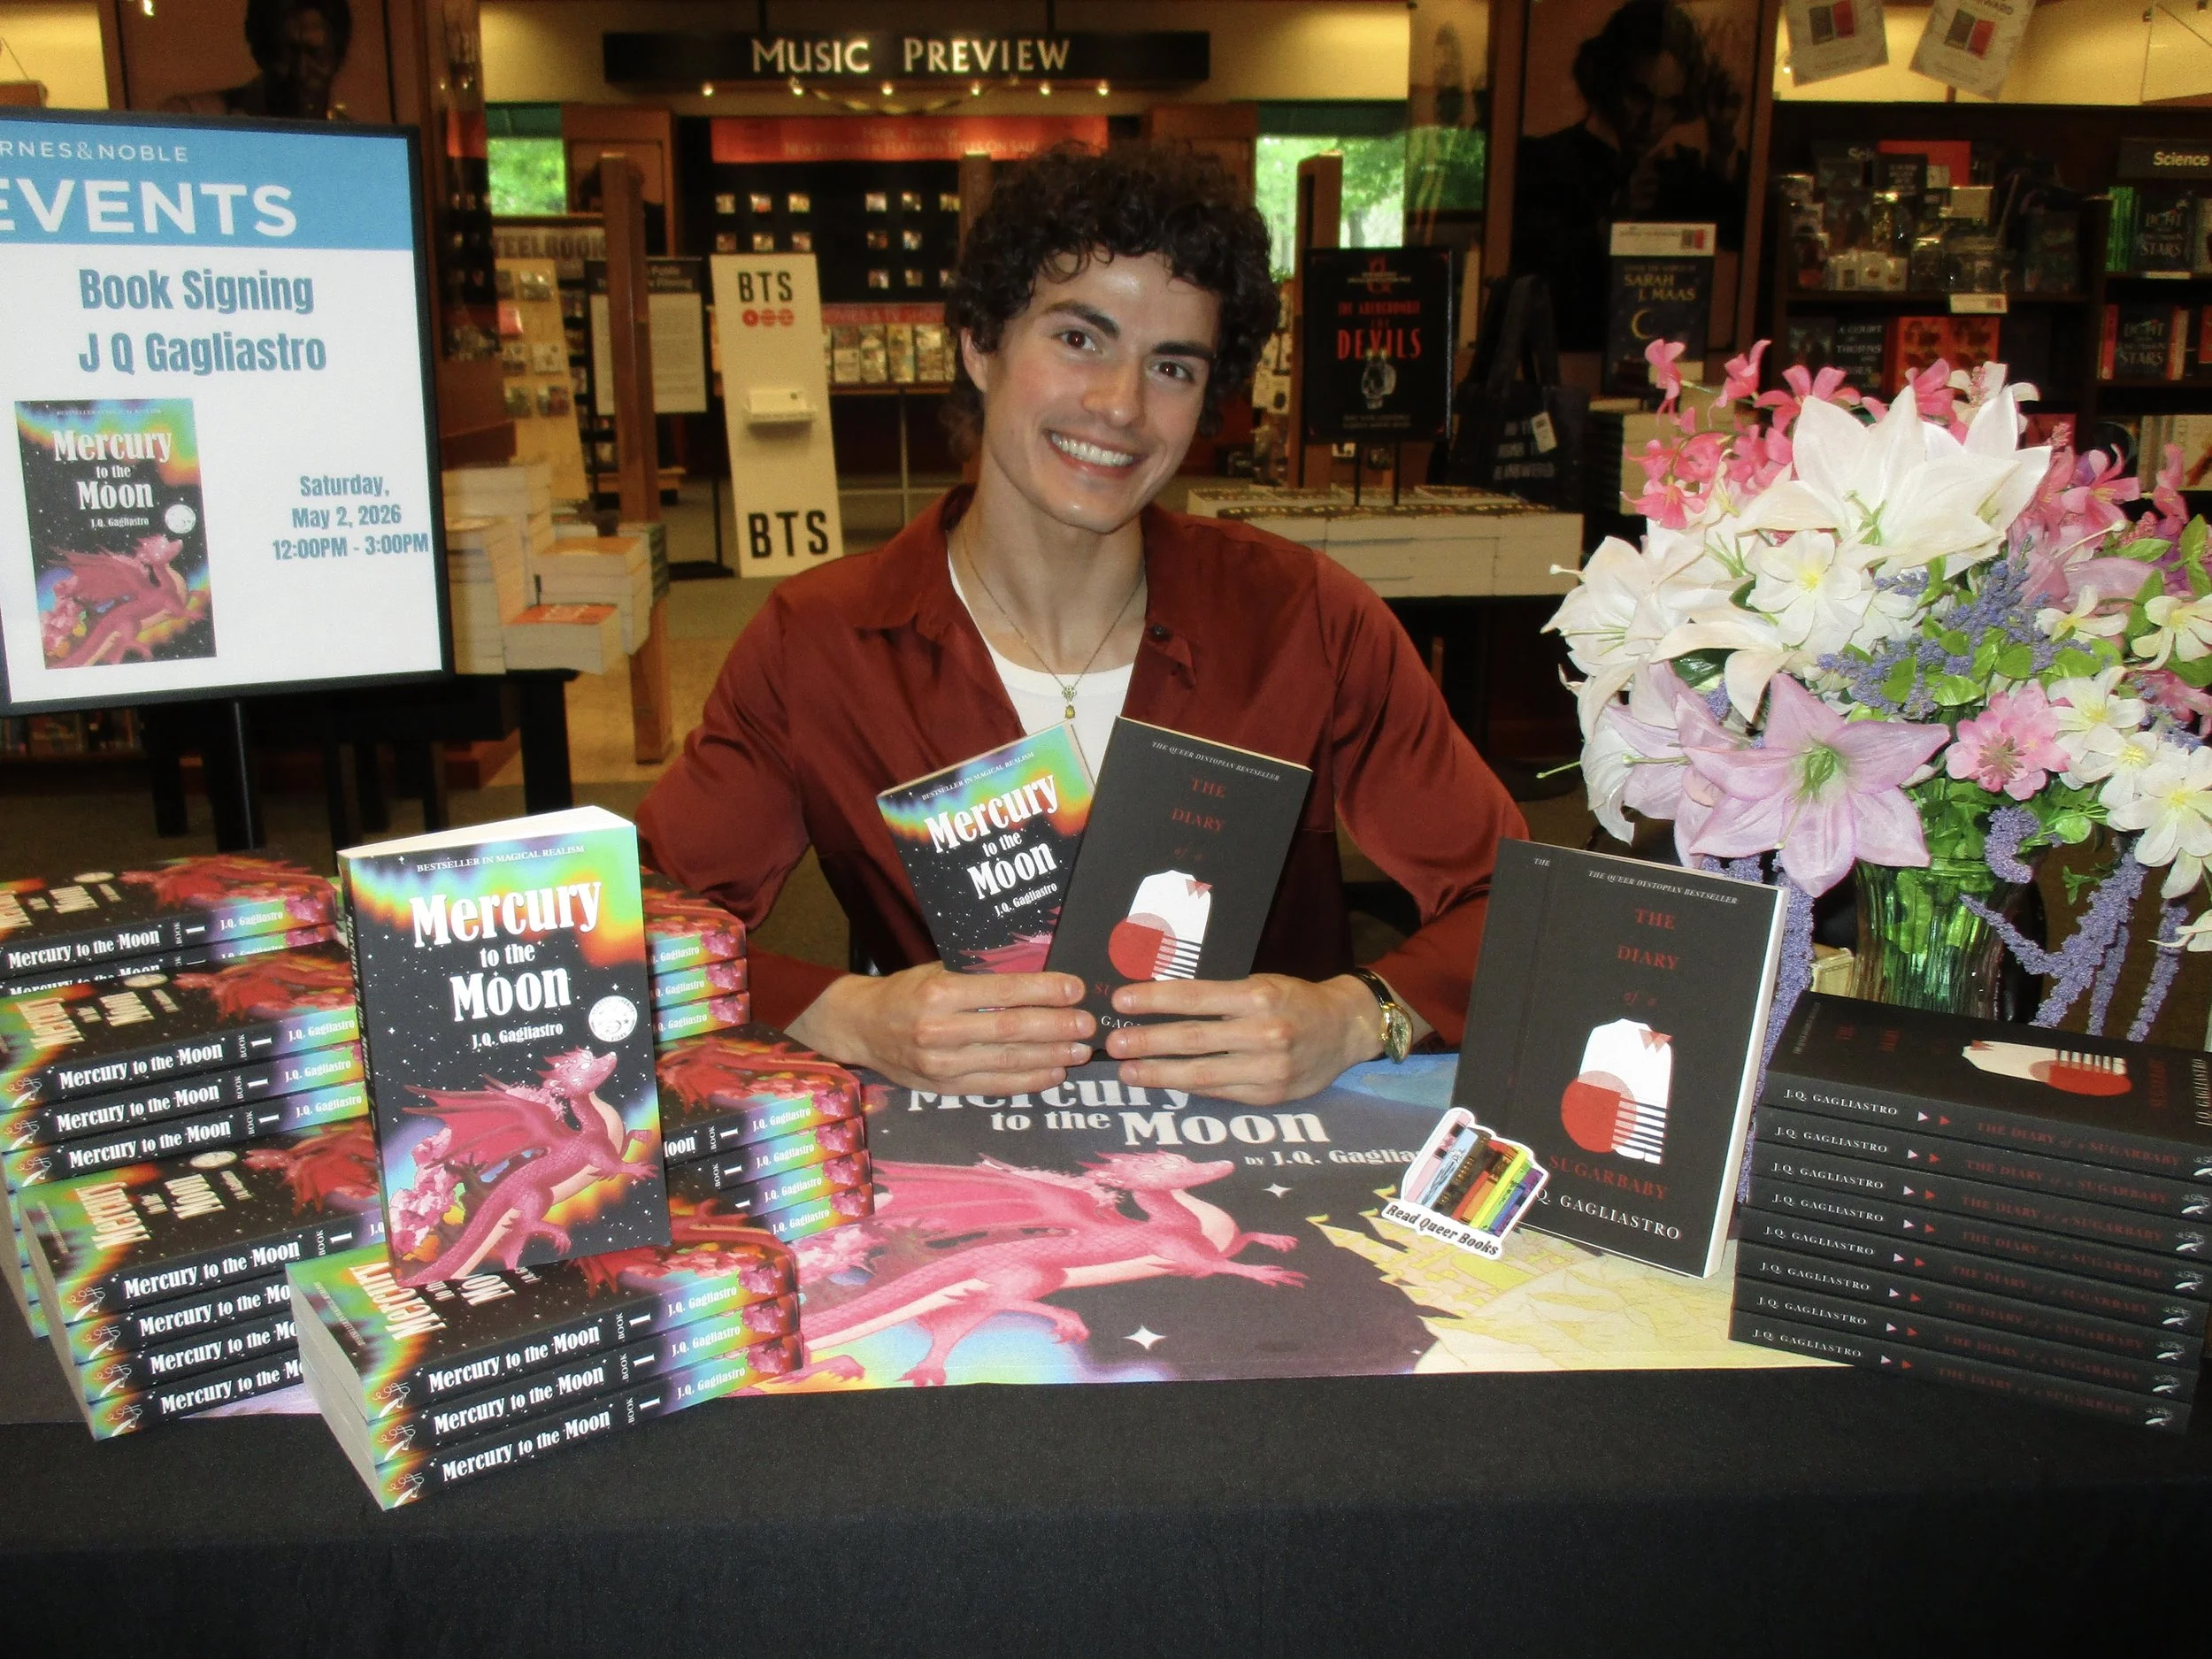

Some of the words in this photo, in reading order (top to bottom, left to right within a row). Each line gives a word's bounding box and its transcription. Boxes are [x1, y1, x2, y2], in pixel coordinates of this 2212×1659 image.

[751, 38, 871, 73] MUSIC
[903, 38, 1071, 73] PREVIEW
[2153, 151, 2210, 166] Science
[79, 268, 174, 310] Book
[182, 267, 315, 315] Signing
[738, 270, 793, 303] BTS
[1624, 274, 1675, 287] SARAH
[1652, 288, 1697, 302] MAAS
[79, 333, 100, 373] J
[111, 333, 135, 375] Q
[145, 331, 327, 376] Gagliastro
[1336, 327, 1423, 361] DEVILS
[51, 429, 173, 464] Mercury
[96, 465, 110, 479] to
[111, 465, 133, 479] the
[300, 473, 390, 496] Saturday,
[77, 480, 155, 511] Moon
[291, 507, 331, 530] May
[335, 506, 354, 529] 2,
[358, 503, 403, 526] 2026
[749, 508, 829, 559] BTS
[273, 536, 349, 561] 12:00PM
[365, 532, 430, 556] 3:00PM
[922, 780, 964, 801] BESTSELLER
[964, 777, 974, 786] IN
[974, 764, 1005, 781] MAGICAL
[1005, 751, 1034, 769] REALISM
[1152, 741, 1168, 752] THE
[1169, 746, 1194, 759] QUEER
[1194, 753, 1236, 769] DYSTOPIAN
[1235, 764, 1280, 782] BESTSELLER
[1191, 777, 1226, 797] THE
[924, 775, 1058, 854] Mercury
[1171, 807, 1226, 833] DIARY
[417, 856, 480, 872] BESTSELLER
[482, 856, 494, 864] IN
[495, 850, 541, 864] MAGICAL
[542, 844, 585, 857] REALISM
[982, 841, 998, 857] to
[998, 832, 1023, 850] the
[1533, 857, 1551, 867] THE
[967, 842, 1057, 900] Moon
[1588, 870, 1606, 880] THE
[1607, 874, 1636, 885] QUEER
[1636, 879, 1682, 895] DYSTOPIAN
[1683, 888, 1739, 905] BESTSELLER
[409, 881, 602, 949] Mercury
[994, 902, 1013, 918] J.Q.
[1012, 882, 1058, 909] Gagliastro
[1634, 908, 1677, 930] THE
[8, 945, 72, 970] Mercury
[76, 943, 90, 957] to
[93, 940, 115, 955] the
[118, 930, 161, 950] Moon
[173, 921, 182, 947] BOOK
[220, 919, 237, 931] J.Q.
[239, 910, 284, 928] Gagliastro
[480, 949, 500, 968] to
[504, 942, 536, 964] the
[659, 946, 700, 962] Gagliastro
[1617, 944, 1680, 971] DIARY
[449, 966, 572, 1022] Moon
[471, 1033, 496, 1050] J.Q.
[498, 1022, 564, 1045] Gagliastro
[59, 1063, 127, 1090] Mercury
[133, 1060, 147, 1075] to
[150, 1055, 174, 1071] the
[178, 1043, 223, 1065] Moon
[238, 1034, 248, 1059] BOOK
[288, 1030, 305, 1042] J.Q.
[308, 1019, 355, 1039] Gagliastro
[708, 1125, 717, 1149] BOOK
[753, 1119, 768, 1132] J.Q.
[770, 1107, 811, 1126] Gagliastro
[991, 1110, 1031, 1132] to
[1045, 1108, 1111, 1131] the
[1118, 1110, 1331, 1147] Moon
[1812, 1094, 1898, 1116] GAGLIASTRO
[1977, 1121, 2007, 1135] THE
[2010, 1126, 2055, 1144] DIARY
[1245, 1155, 1265, 1167] by
[1272, 1150, 1322, 1167] J.Q.
[1328, 1148, 1420, 1166] Gaglia
[1803, 1132, 1887, 1153] GAGLIASTRO
[1967, 1159, 1995, 1174] THE
[2000, 1164, 2044, 1182] DIARY
[764, 1190, 780, 1202] J.Q.
[781, 1177, 823, 1197] Gagliastro
[1549, 1155, 1671, 1201] SUGARBABY
[1800, 1167, 1884, 1190] GAGLIASTRO
[1536, 1187, 1551, 1205] Q.
[1560, 1194, 1681, 1240] GAGLIASTRO
[1800, 1199, 1884, 1223] GAGLIASTRO
[1386, 1204, 1419, 1226] Read
[1418, 1213, 1458, 1240] Queer
[1456, 1231, 1499, 1256] Books
[124, 1266, 197, 1299] Mercury
[204, 1263, 219, 1279] to
[222, 1256, 247, 1274] the
[251, 1240, 300, 1267] Moon
[139, 1302, 212, 1337] Mercury
[218, 1300, 234, 1317] to
[237, 1293, 262, 1311] the
[266, 1283, 290, 1304] Mo
[428, 1356, 500, 1393] Mercury
[505, 1352, 521, 1369] to
[525, 1345, 549, 1363] the
[553, 1325, 601, 1355] Moon
[616, 1312, 625, 1341] BOOK
[668, 1302, 686, 1317] J.Q.
[688, 1286, 738, 1310] Gagliastro
[1779, 1333, 1862, 1357] GAGLIASTRO
[442, 1443, 513, 1482] Mercury
[518, 1440, 534, 1456] to
[536, 1431, 560, 1448] the
[565, 1410, 611, 1440] Moon
[626, 1396, 635, 1425] BOOK
[677, 1384, 695, 1400] J.Q.
[697, 1367, 746, 1392] Gagliastro
